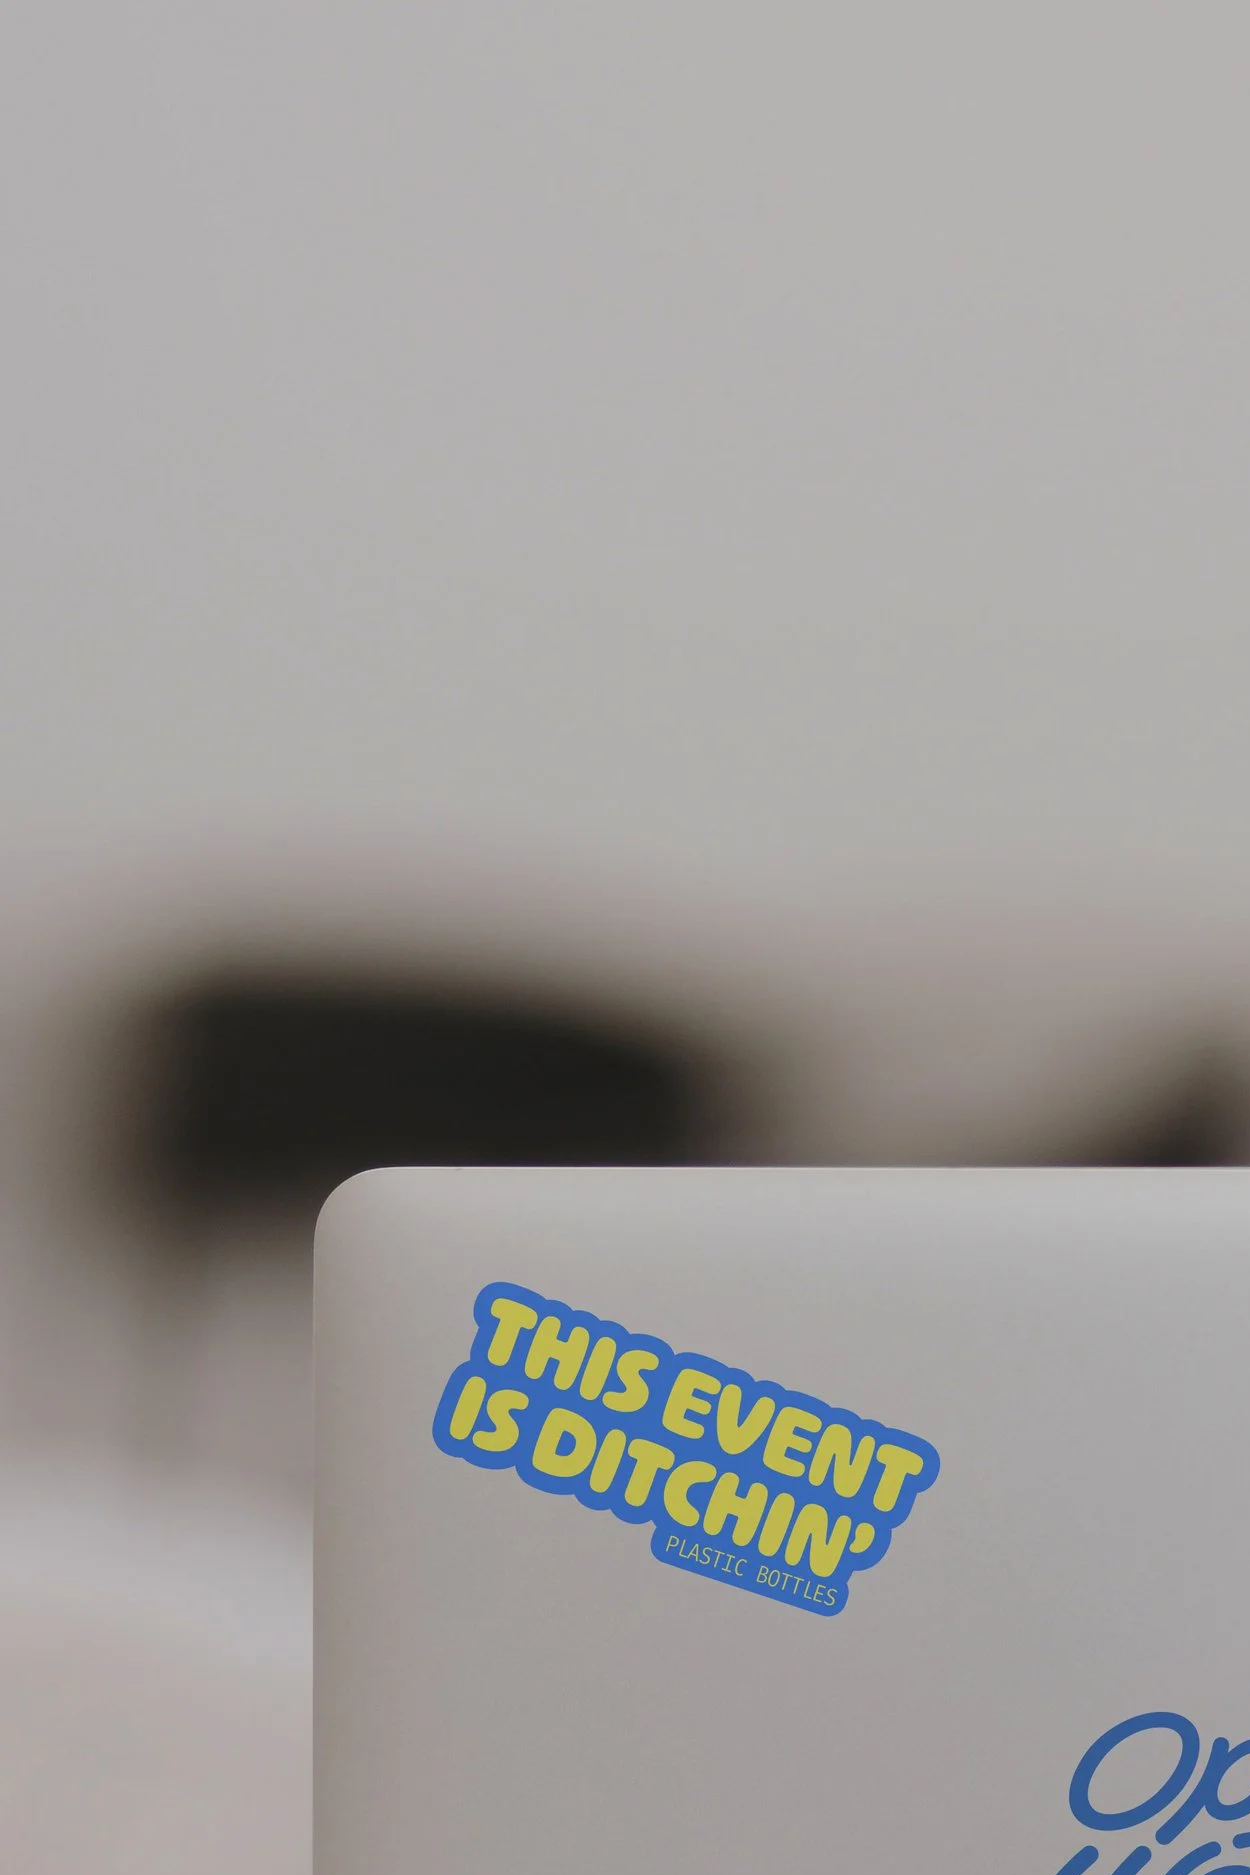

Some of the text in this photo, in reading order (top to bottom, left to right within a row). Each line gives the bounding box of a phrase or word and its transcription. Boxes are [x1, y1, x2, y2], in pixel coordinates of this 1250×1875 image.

[449, 1376, 529, 1452] IS
[487, 1298, 924, 1512] THIS EVENT
[666, 1536, 838, 1606] PLASTIC BOTTLES
